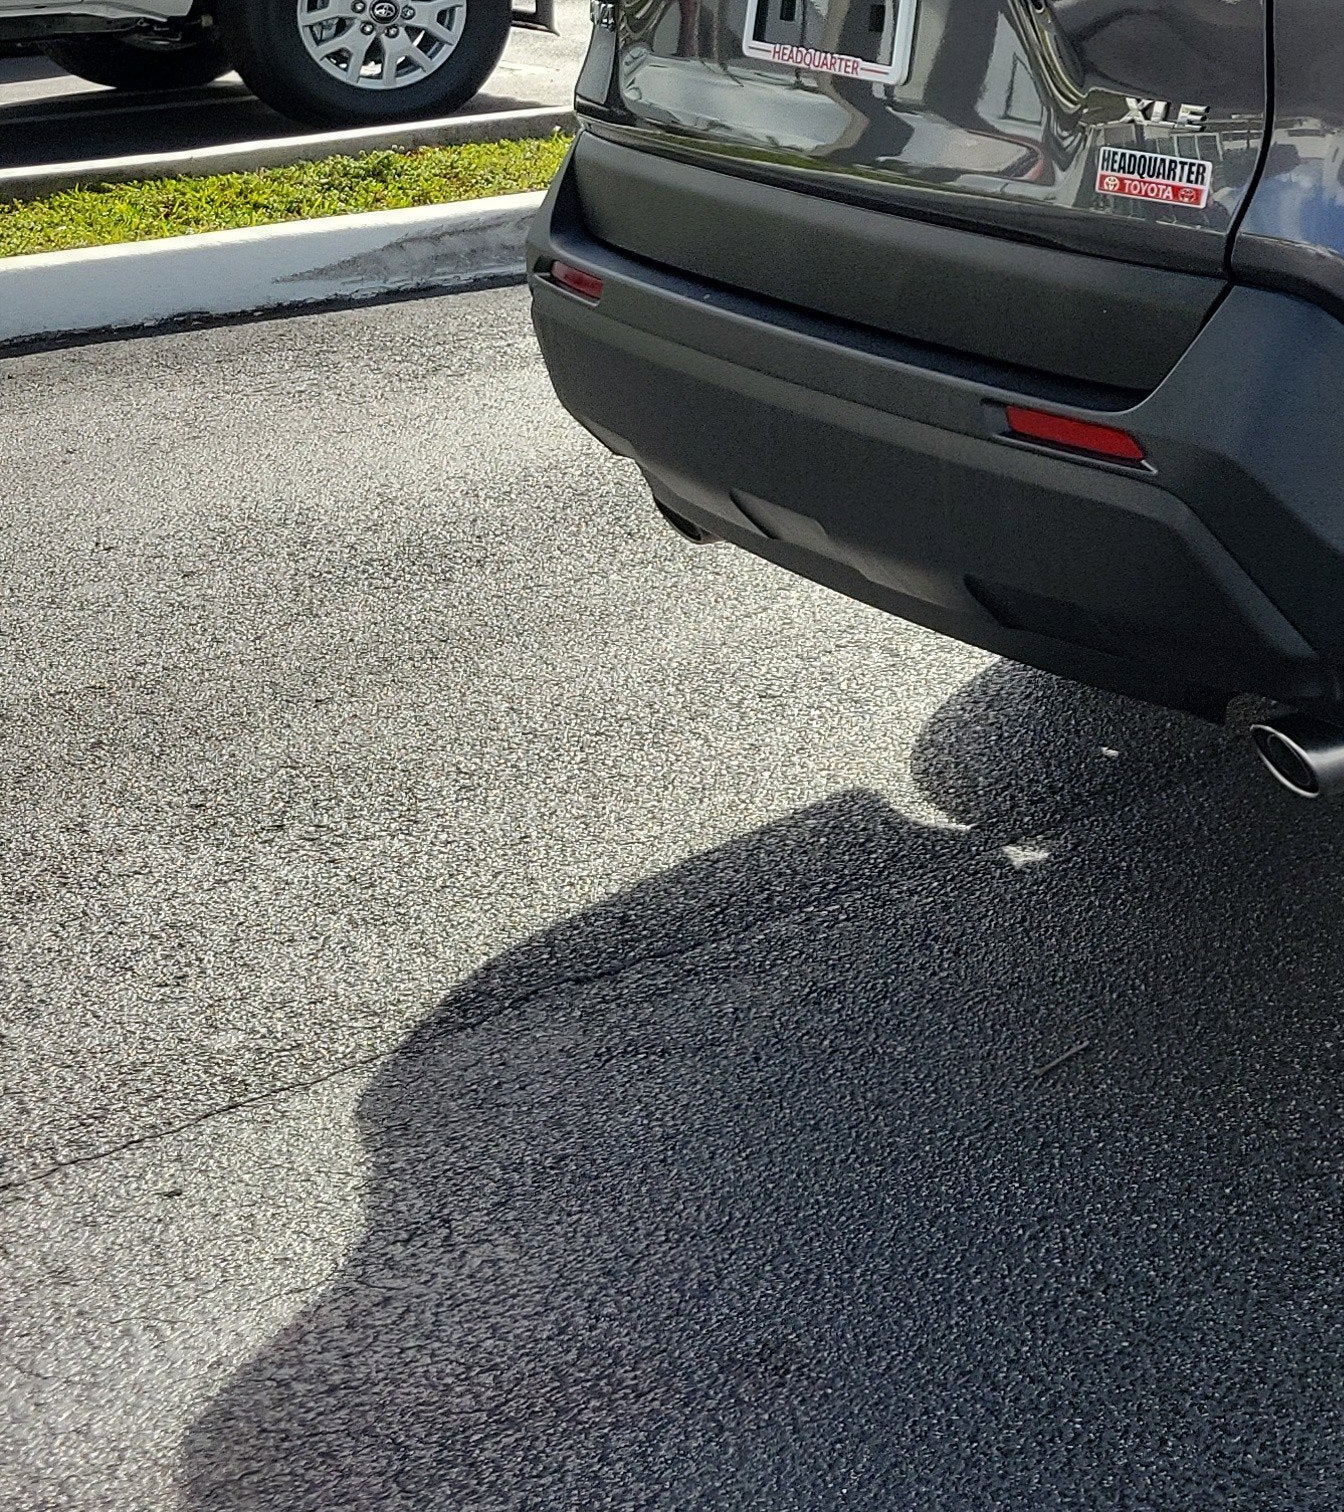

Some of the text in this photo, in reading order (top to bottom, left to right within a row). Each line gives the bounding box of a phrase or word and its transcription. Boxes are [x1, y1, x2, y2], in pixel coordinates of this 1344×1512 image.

[772, 44, 860, 76] HEADQUARTER
[1119, 97, 1210, 133] XLE
[1100, 149, 1207, 186] HEADQUARTER
[1124, 180, 1174, 200] TOYOTA
